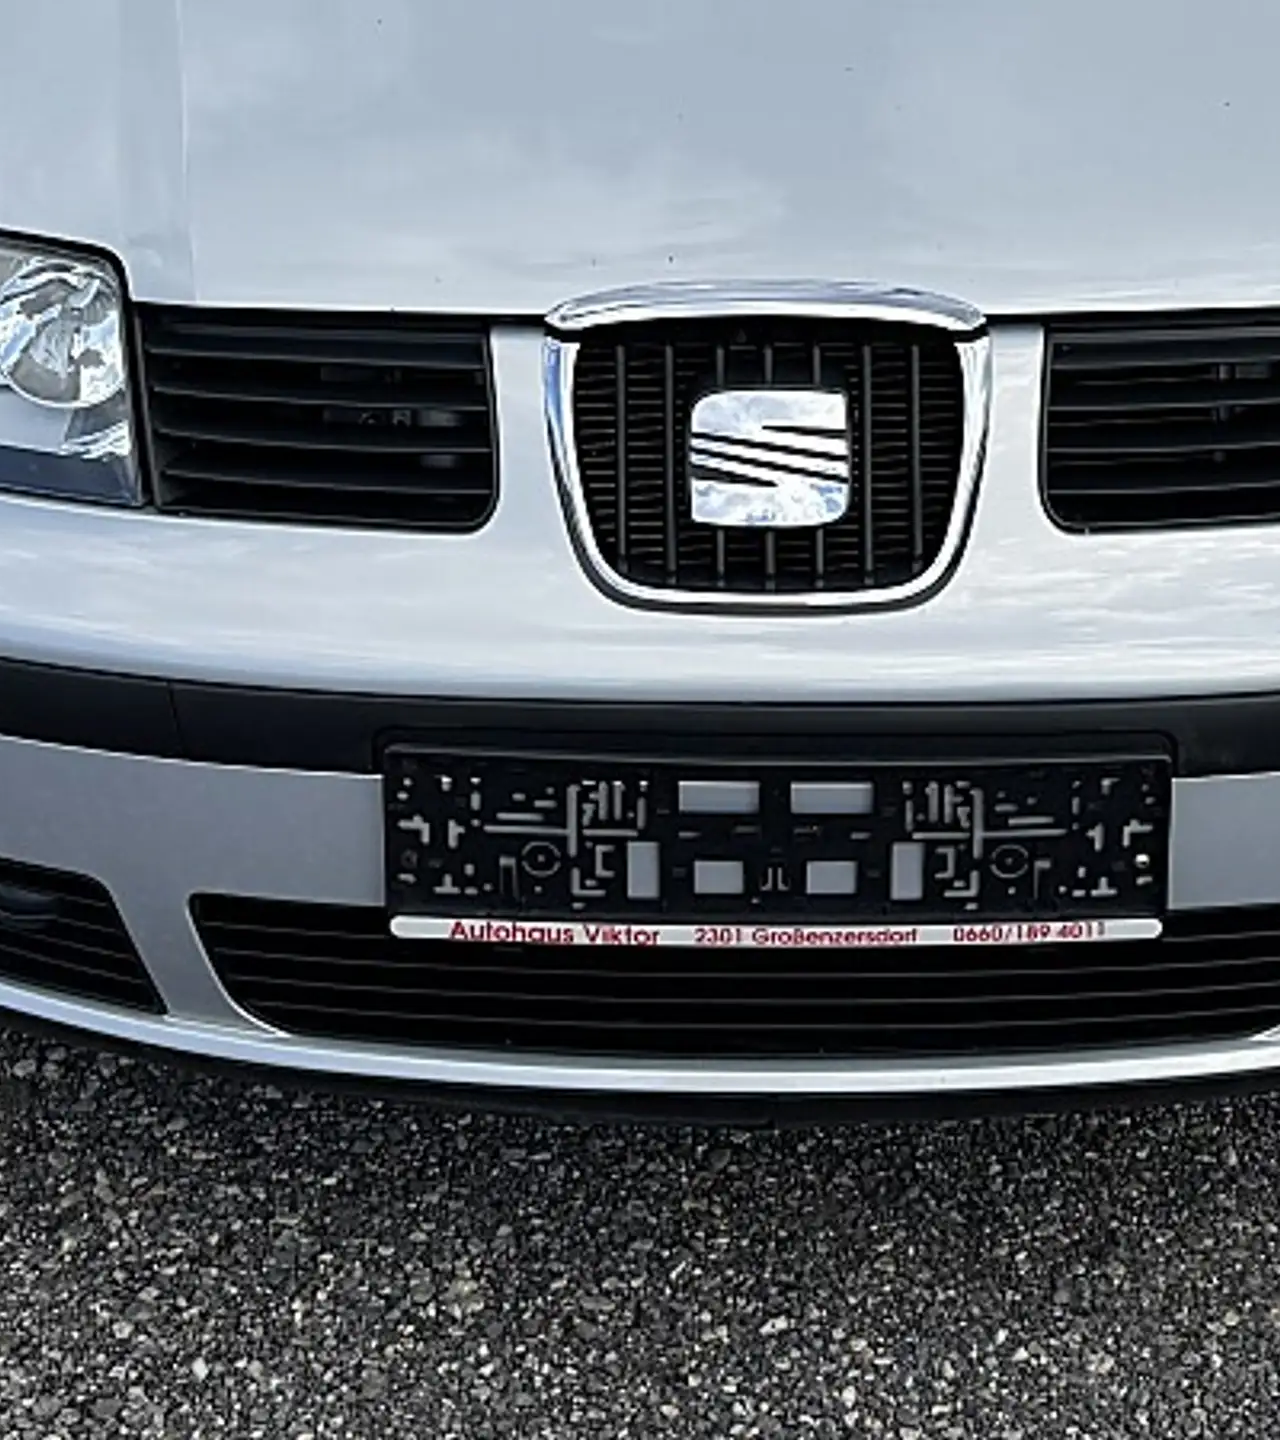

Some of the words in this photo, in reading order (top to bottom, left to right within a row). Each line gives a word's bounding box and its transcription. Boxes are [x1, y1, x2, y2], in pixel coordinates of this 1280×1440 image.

[450, 920, 575, 942] Autohaus
[583, 923, 660, 945] Viktor
[694, 928, 743, 944] 2301
[752, 927, 918, 945] Großenzersdorf
[1057, 921, 1106, 939] 4011
